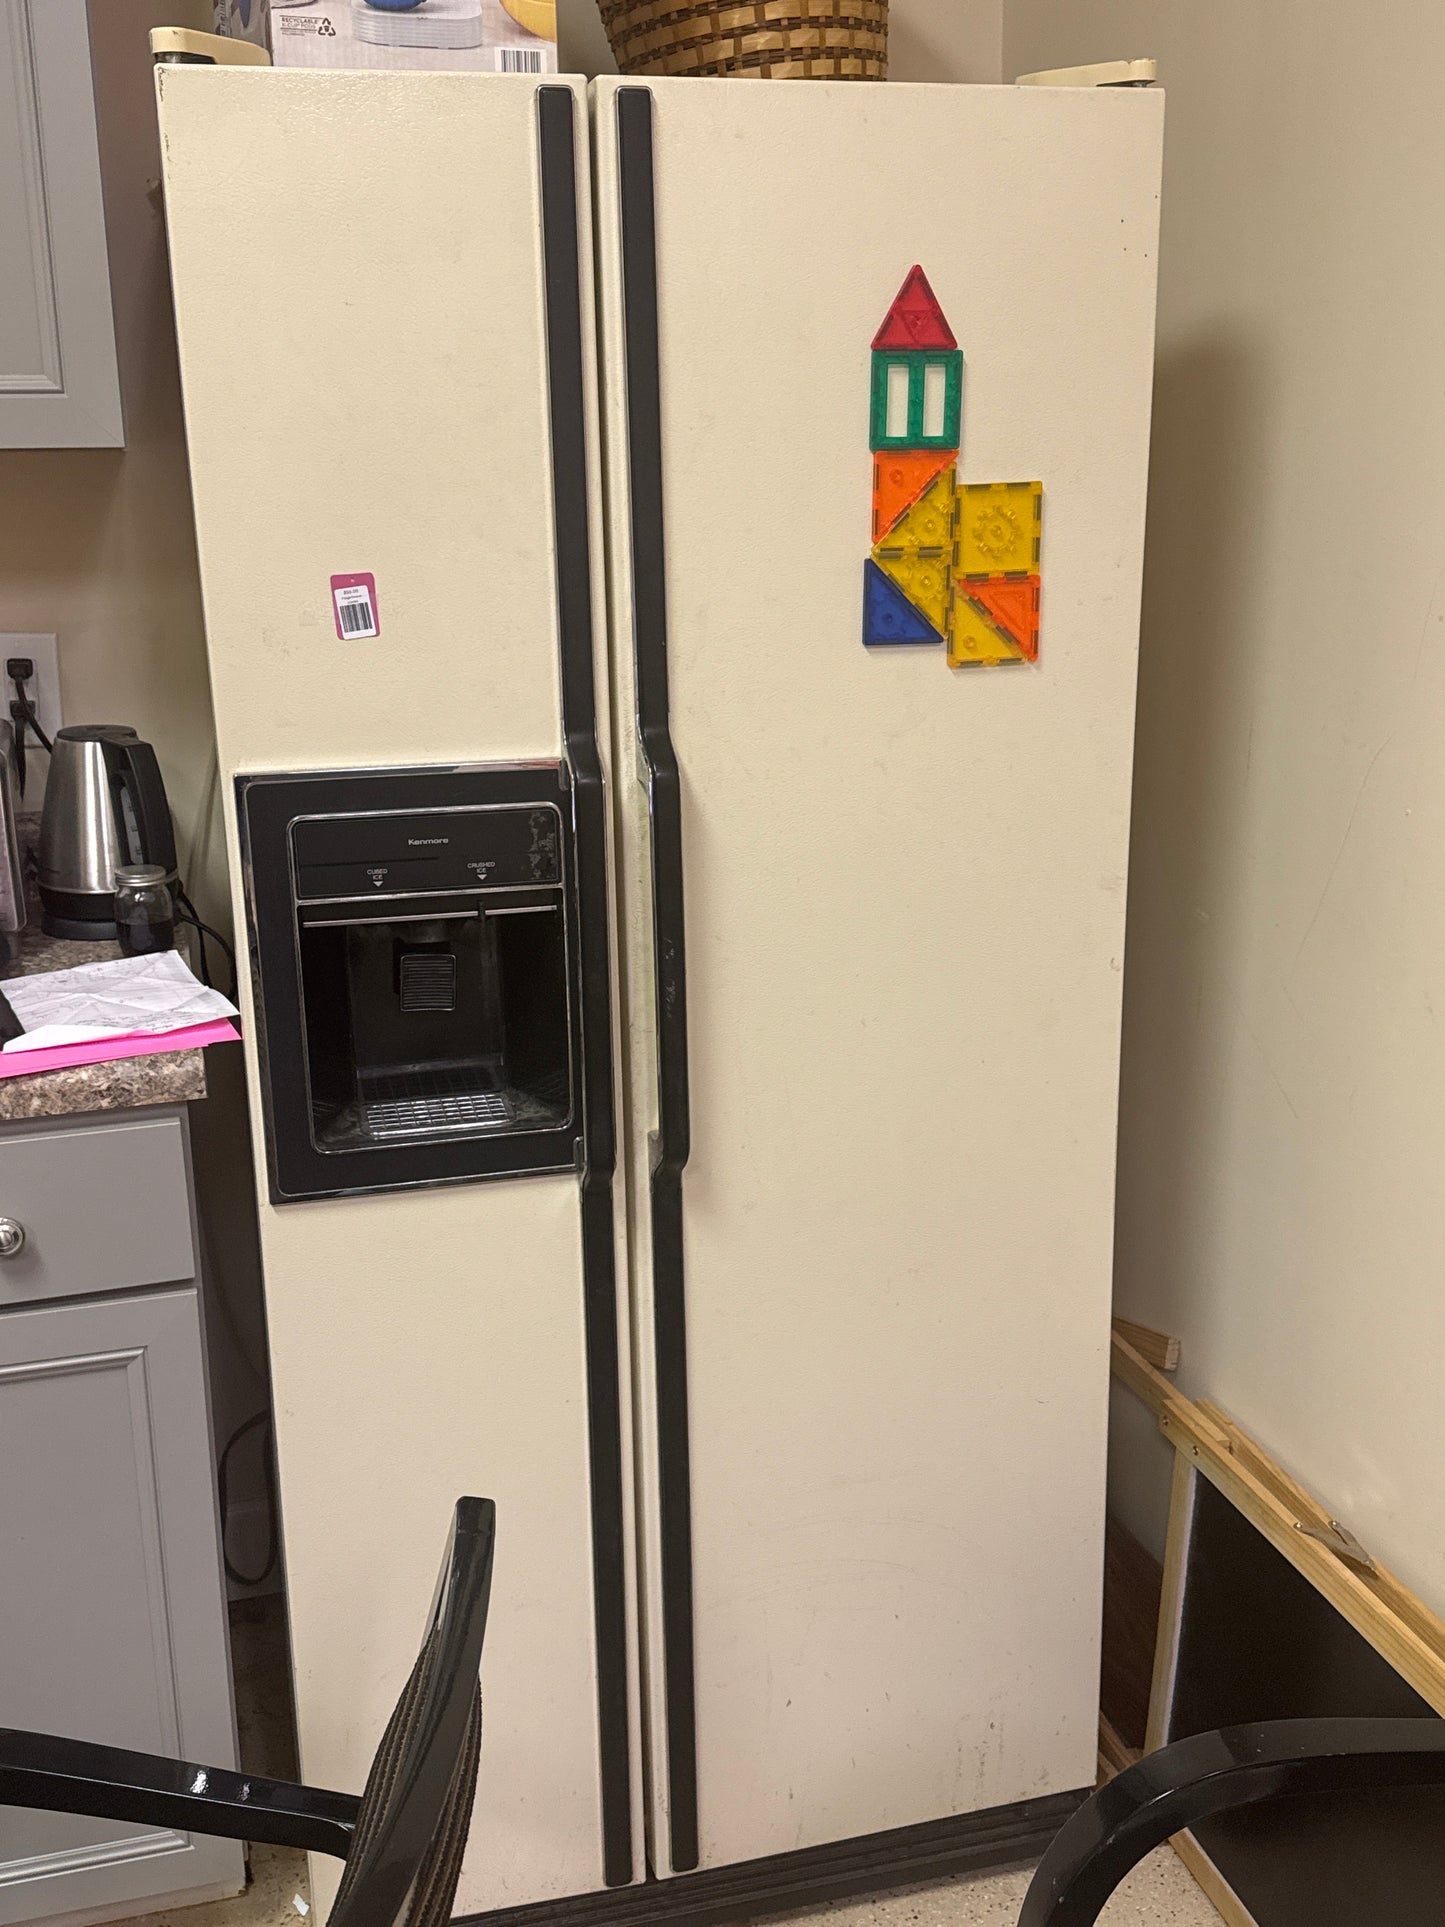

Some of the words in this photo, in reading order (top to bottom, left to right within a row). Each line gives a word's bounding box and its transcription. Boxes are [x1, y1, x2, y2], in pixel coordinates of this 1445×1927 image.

[408, 838, 449, 846] Kenmore
[467, 861, 496, 869] CRUSHED
[366, 868, 388, 876] CUBED
